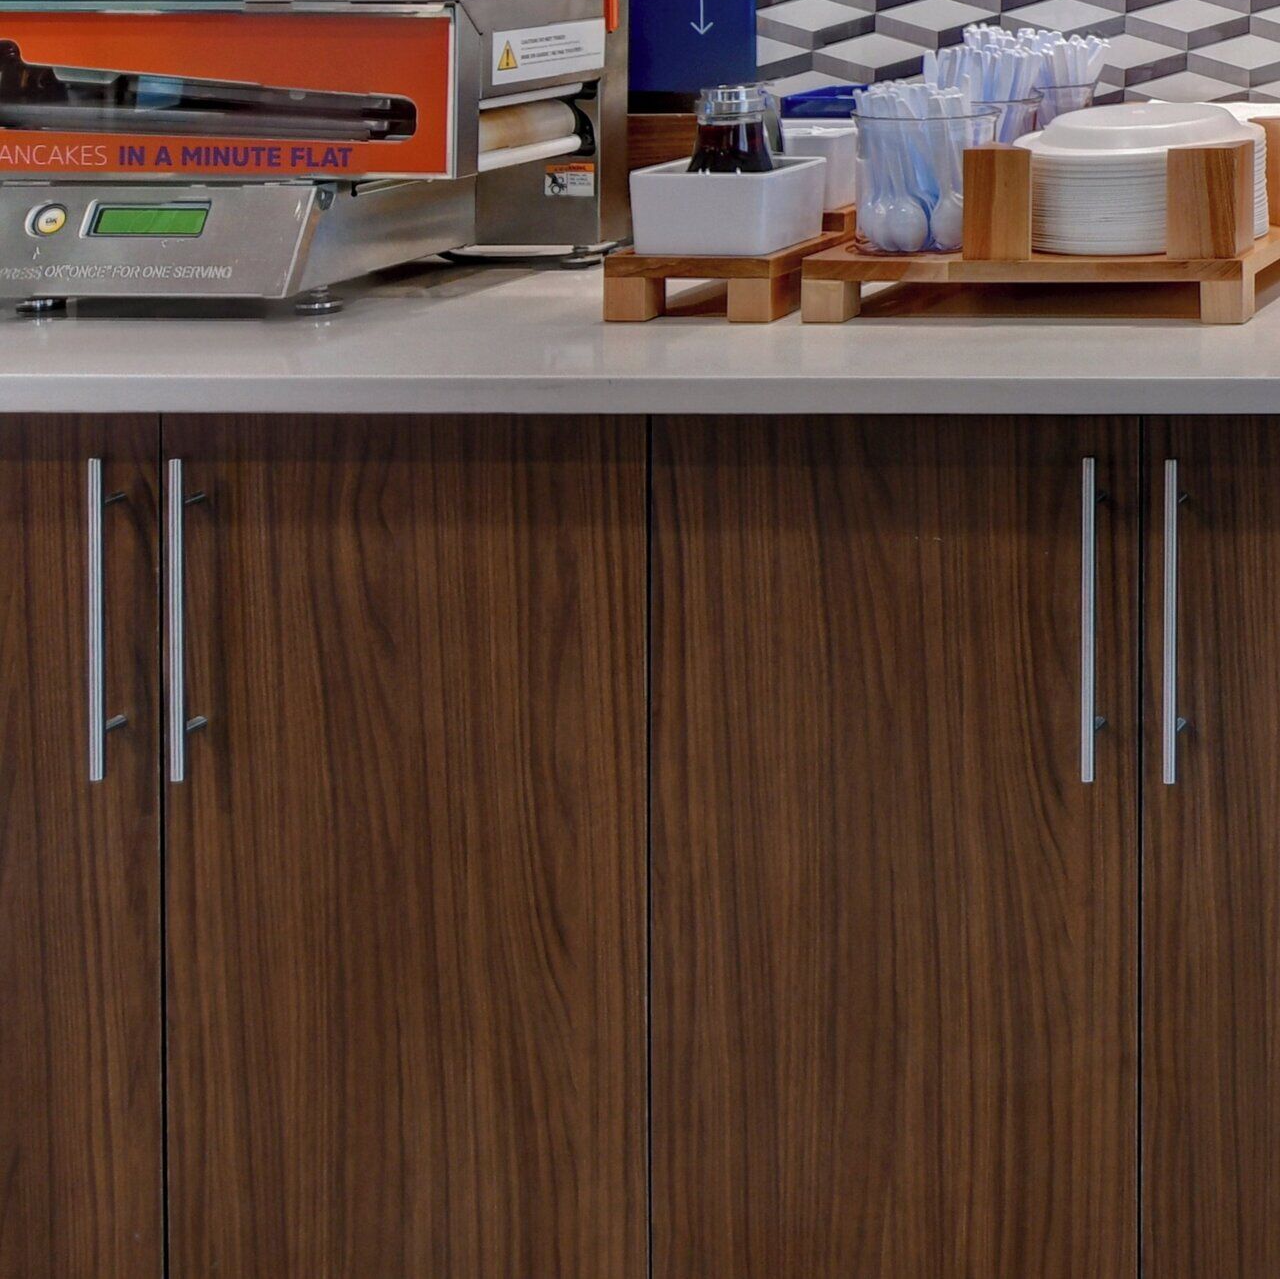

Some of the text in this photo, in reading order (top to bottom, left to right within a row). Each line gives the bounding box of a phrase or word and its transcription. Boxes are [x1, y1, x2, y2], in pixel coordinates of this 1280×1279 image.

[118, 146, 145, 165] IN
[154, 146, 172, 167] A
[180, 146, 281, 167] MINUTE
[290, 147, 353, 168] FLAT
[0, 265, 41, 279] PRESS
[112, 265, 140, 278] FOR
[142, 265, 171, 278] ONE
[173, 265, 232, 278] SERVING
